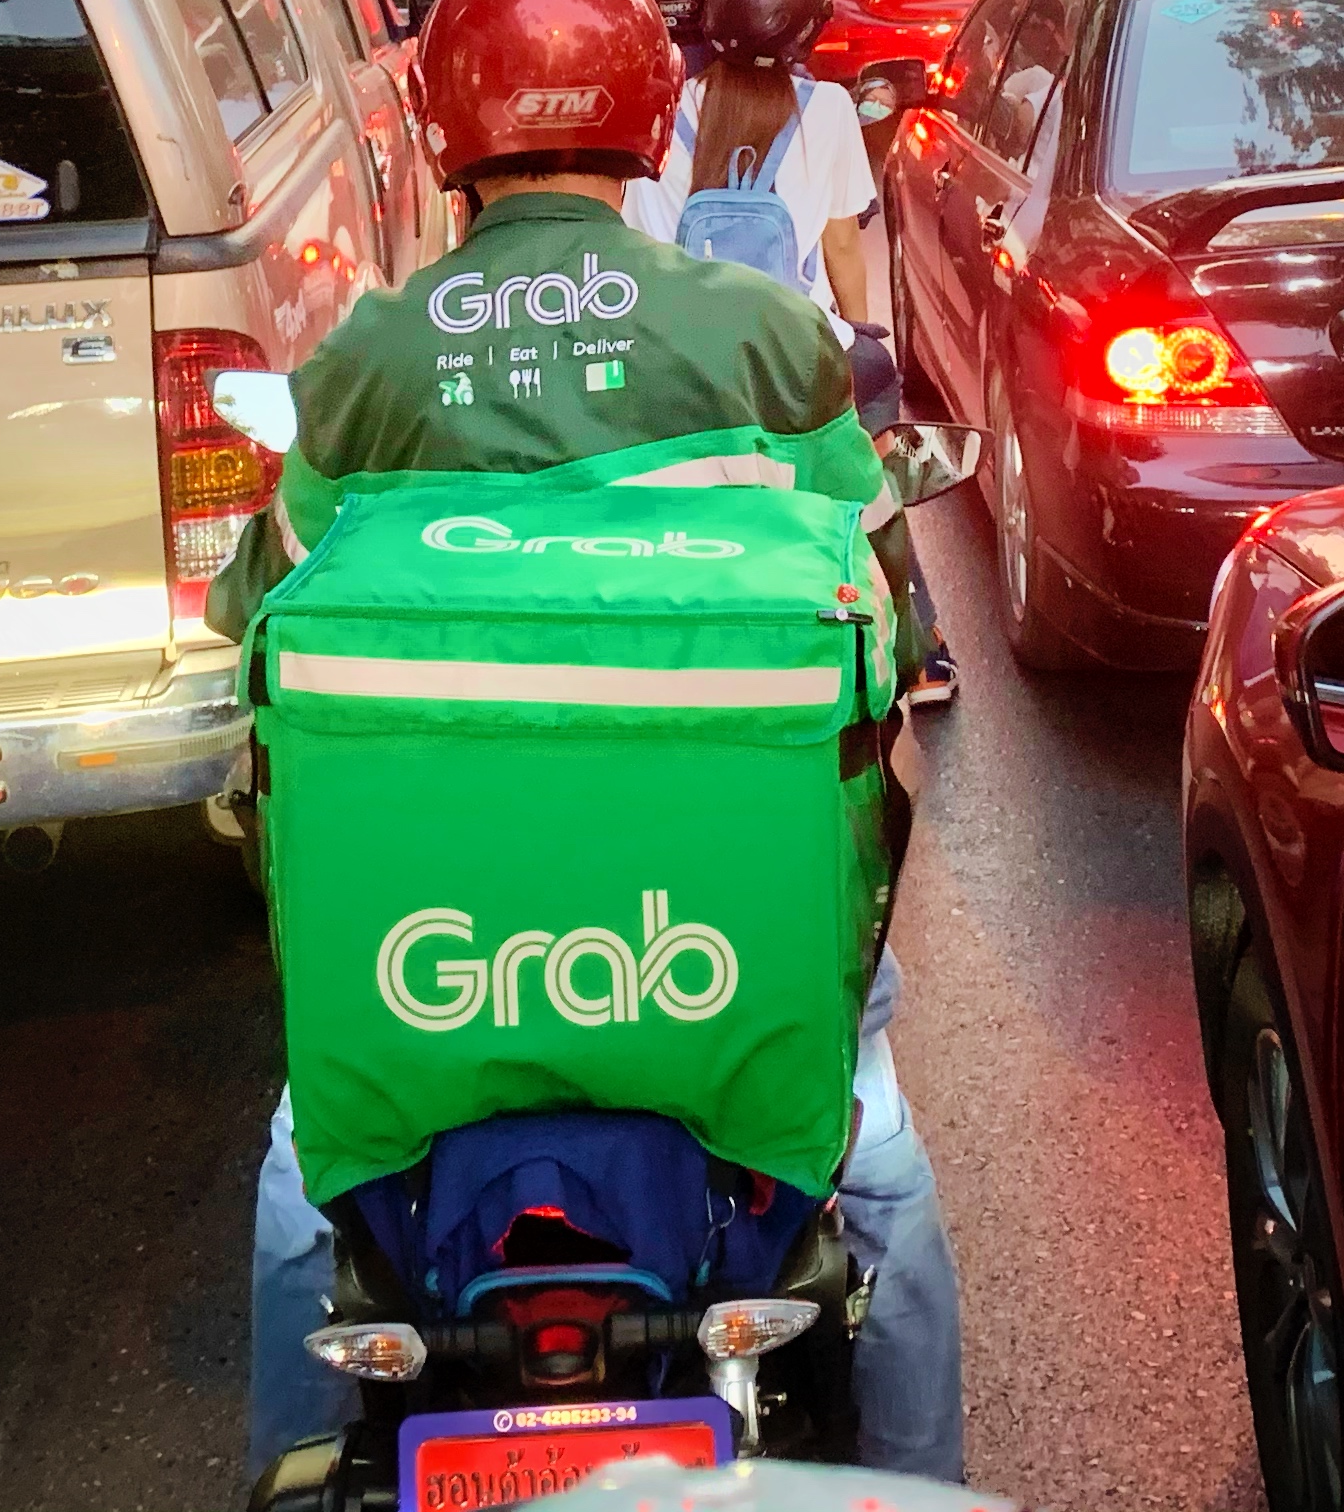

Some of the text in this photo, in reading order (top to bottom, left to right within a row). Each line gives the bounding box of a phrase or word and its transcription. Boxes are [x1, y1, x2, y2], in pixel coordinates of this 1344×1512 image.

[516, 89, 600, 115] STM
[428, 253, 639, 334] Grab
[437, 338, 635, 370] Ride Eat Deliver
[421, 515, 745, 561] Grab
[376, 889, 739, 1032] Grab
